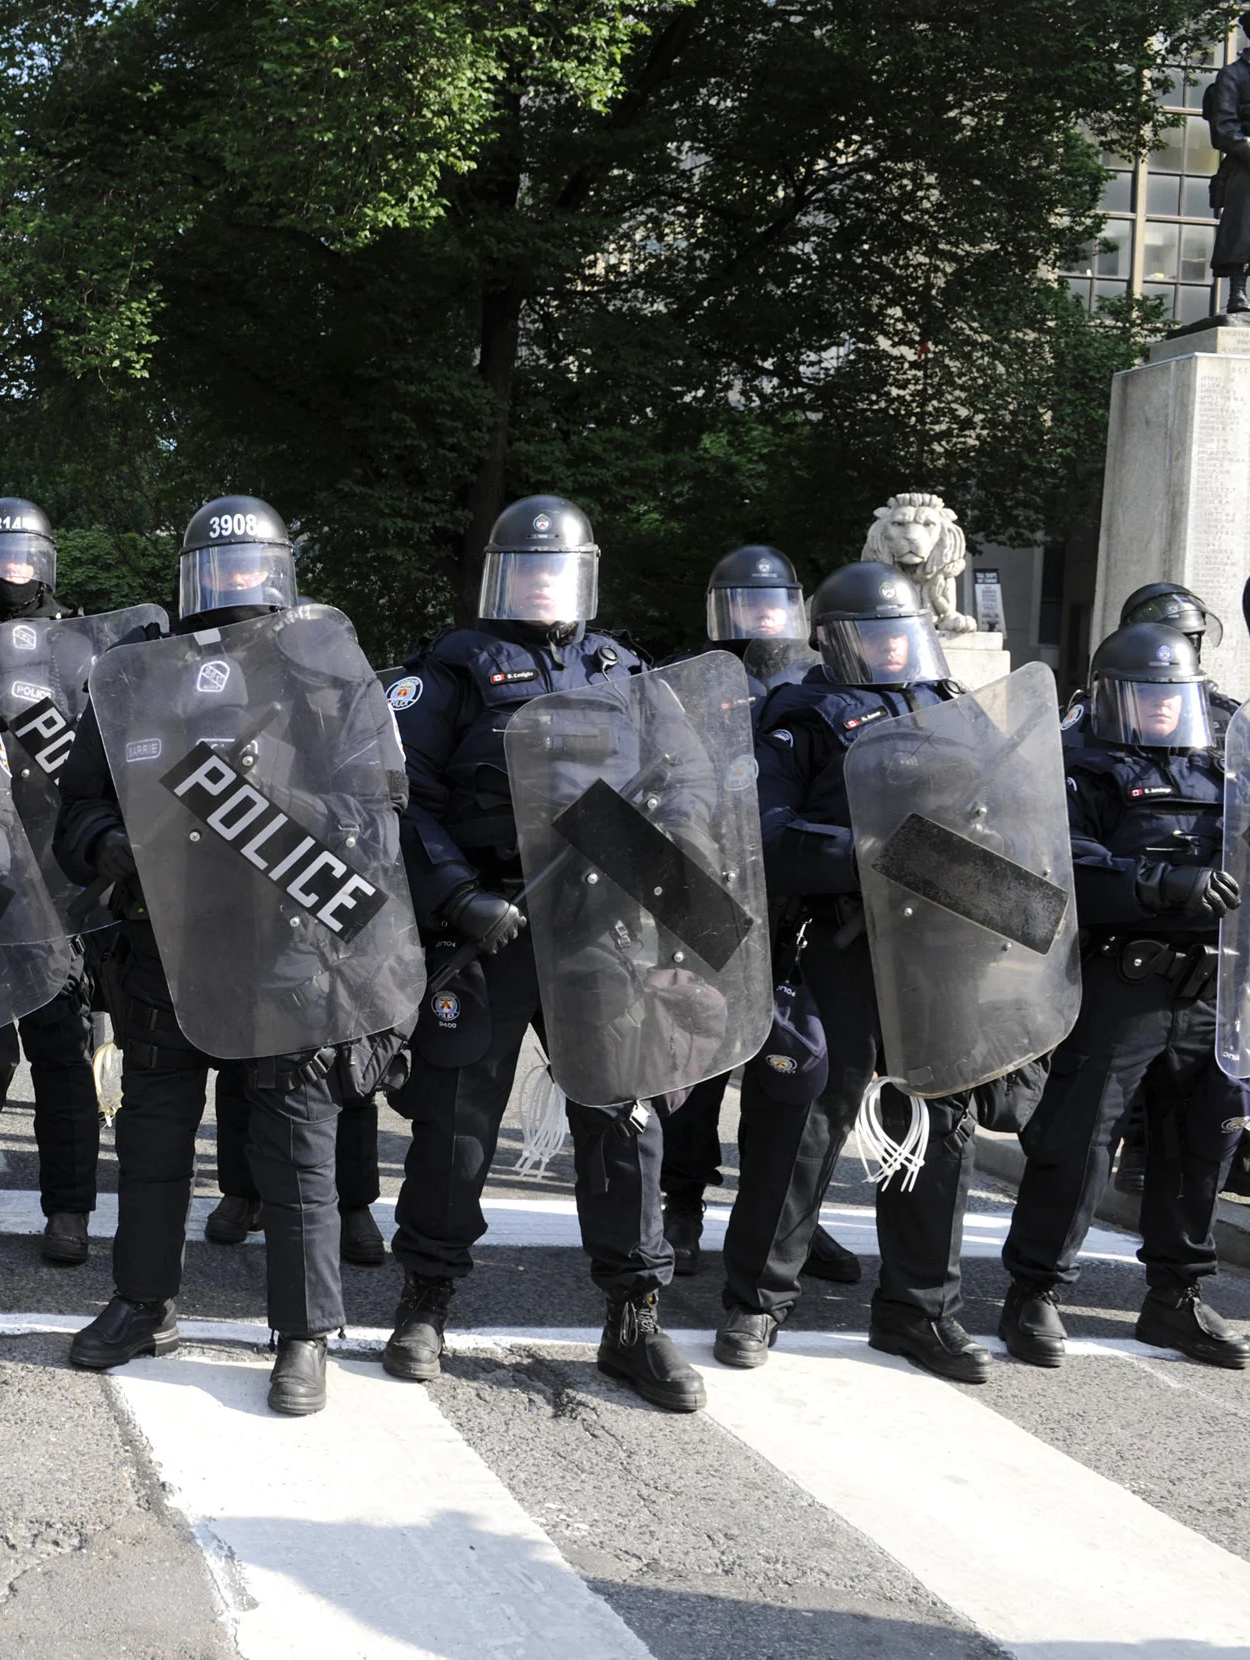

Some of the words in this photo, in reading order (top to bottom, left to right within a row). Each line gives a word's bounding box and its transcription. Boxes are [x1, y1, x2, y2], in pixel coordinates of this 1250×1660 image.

[209, 513, 258, 539] 3908
[128, 742, 158, 758] BARRIE
[173, 753, 376, 933] POLICE
